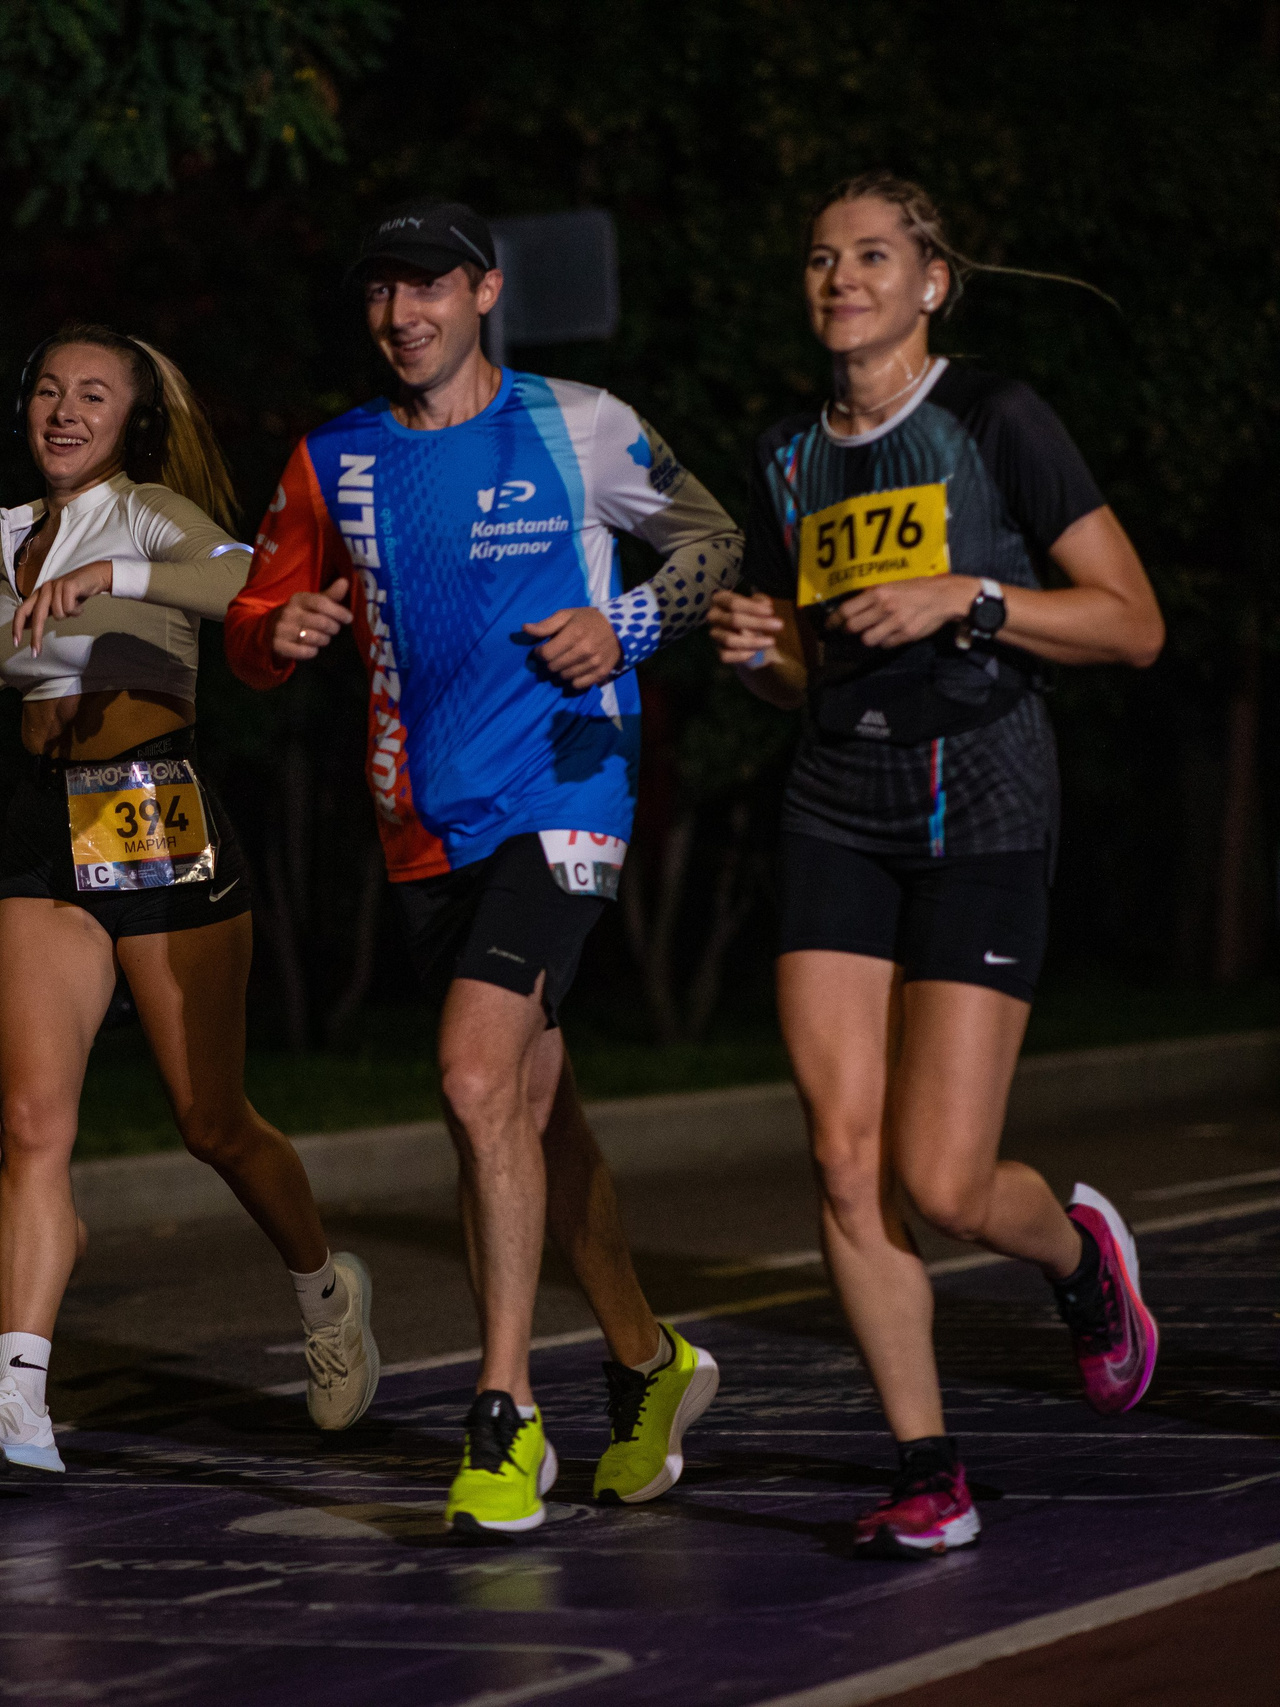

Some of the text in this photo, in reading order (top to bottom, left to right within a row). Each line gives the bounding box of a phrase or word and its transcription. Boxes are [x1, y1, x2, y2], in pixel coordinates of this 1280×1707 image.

[380, 507, 394, 535] club
[470, 515, 570, 539] Konstantin
[817, 502, 925, 569] 5176
[382, 536, 401, 588] running
[469, 540, 553, 562] Kiryanov
[337, 453, 404, 826] RUN ZEPPELIN
[137, 737, 173, 758] NIKE
[114, 795, 190, 839] 394
[124, 836, 177, 854] МАРИЯ
[94, 865, 110, 884] C
[574, 863, 588, 886] C
